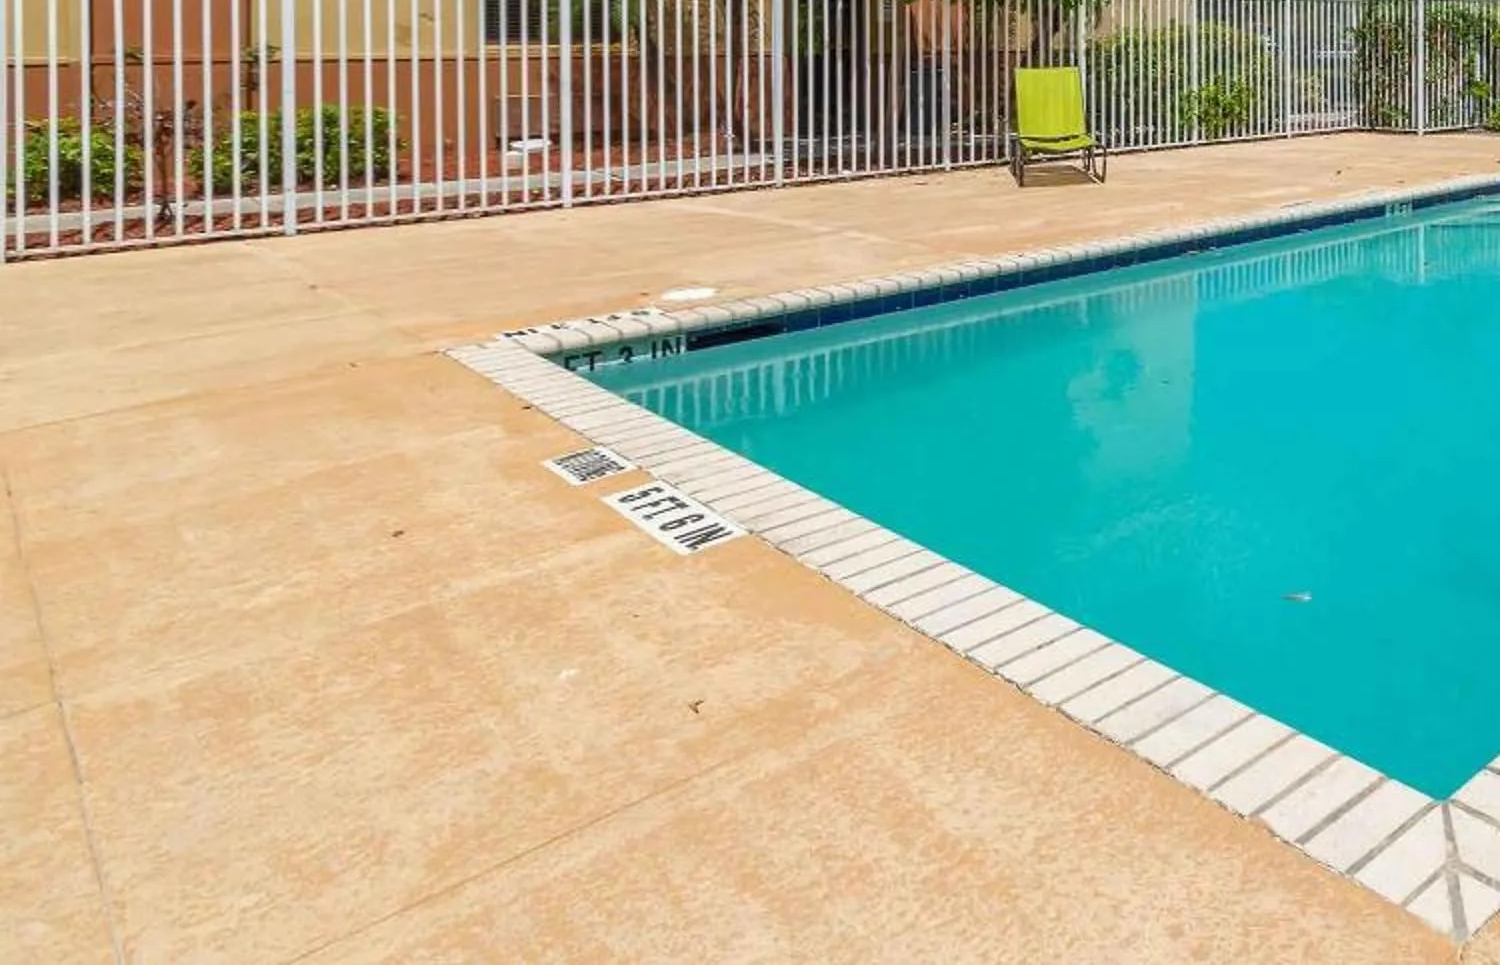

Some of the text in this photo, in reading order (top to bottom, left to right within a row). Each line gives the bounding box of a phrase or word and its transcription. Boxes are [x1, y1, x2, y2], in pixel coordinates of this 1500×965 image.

[652, 336, 682, 359] IN
[618, 486, 665, 503] 5
[659, 513, 705, 532] 6
